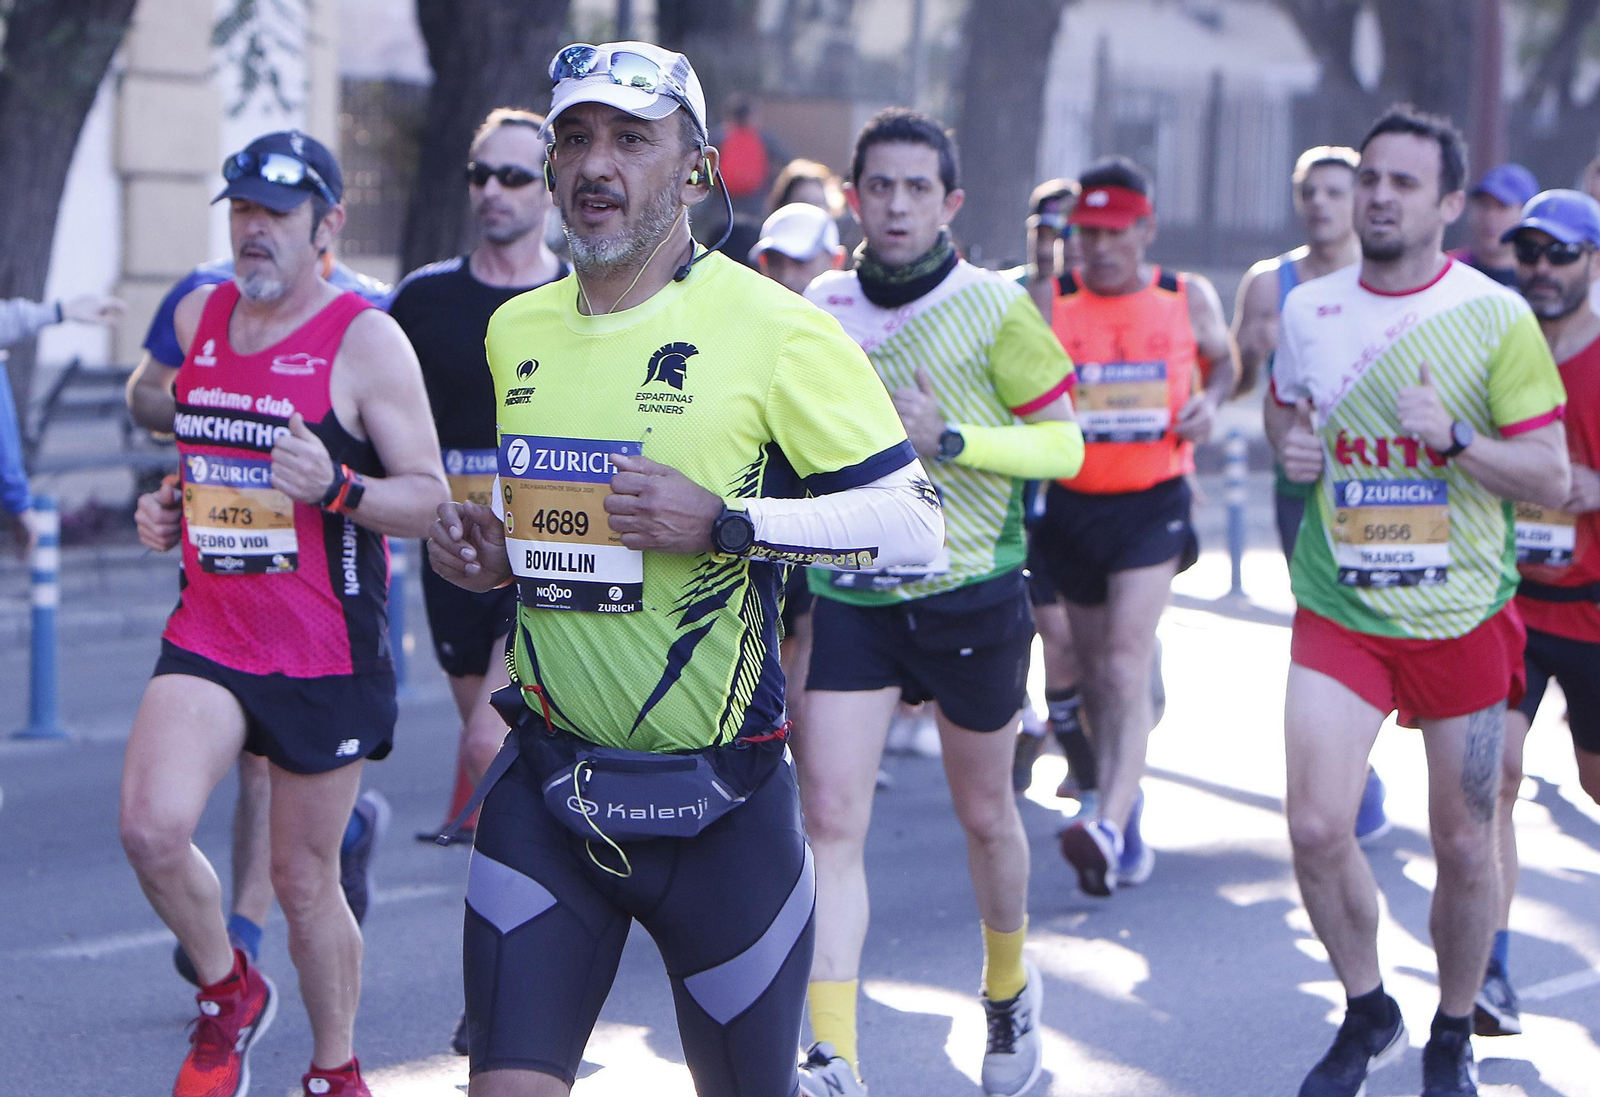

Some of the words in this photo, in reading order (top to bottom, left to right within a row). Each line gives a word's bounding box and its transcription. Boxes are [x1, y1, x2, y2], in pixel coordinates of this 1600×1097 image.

[187, 387, 253, 410] atletismo
[255, 394, 295, 417] club
[635, 392, 694, 404] ESPARTINAS
[637, 403, 685, 415] RUNNERS
[534, 449, 619, 474] ZURICH
[208, 505, 253, 525] 4473
[532, 508, 589, 536] 4689
[239, 535, 269, 549] VIDI
[1363, 523, 1411, 541] 5956
[525, 549, 595, 573] BOVILLIN
[597, 603, 635, 613] ZURICH
[607, 797, 708, 820] Kalenji
